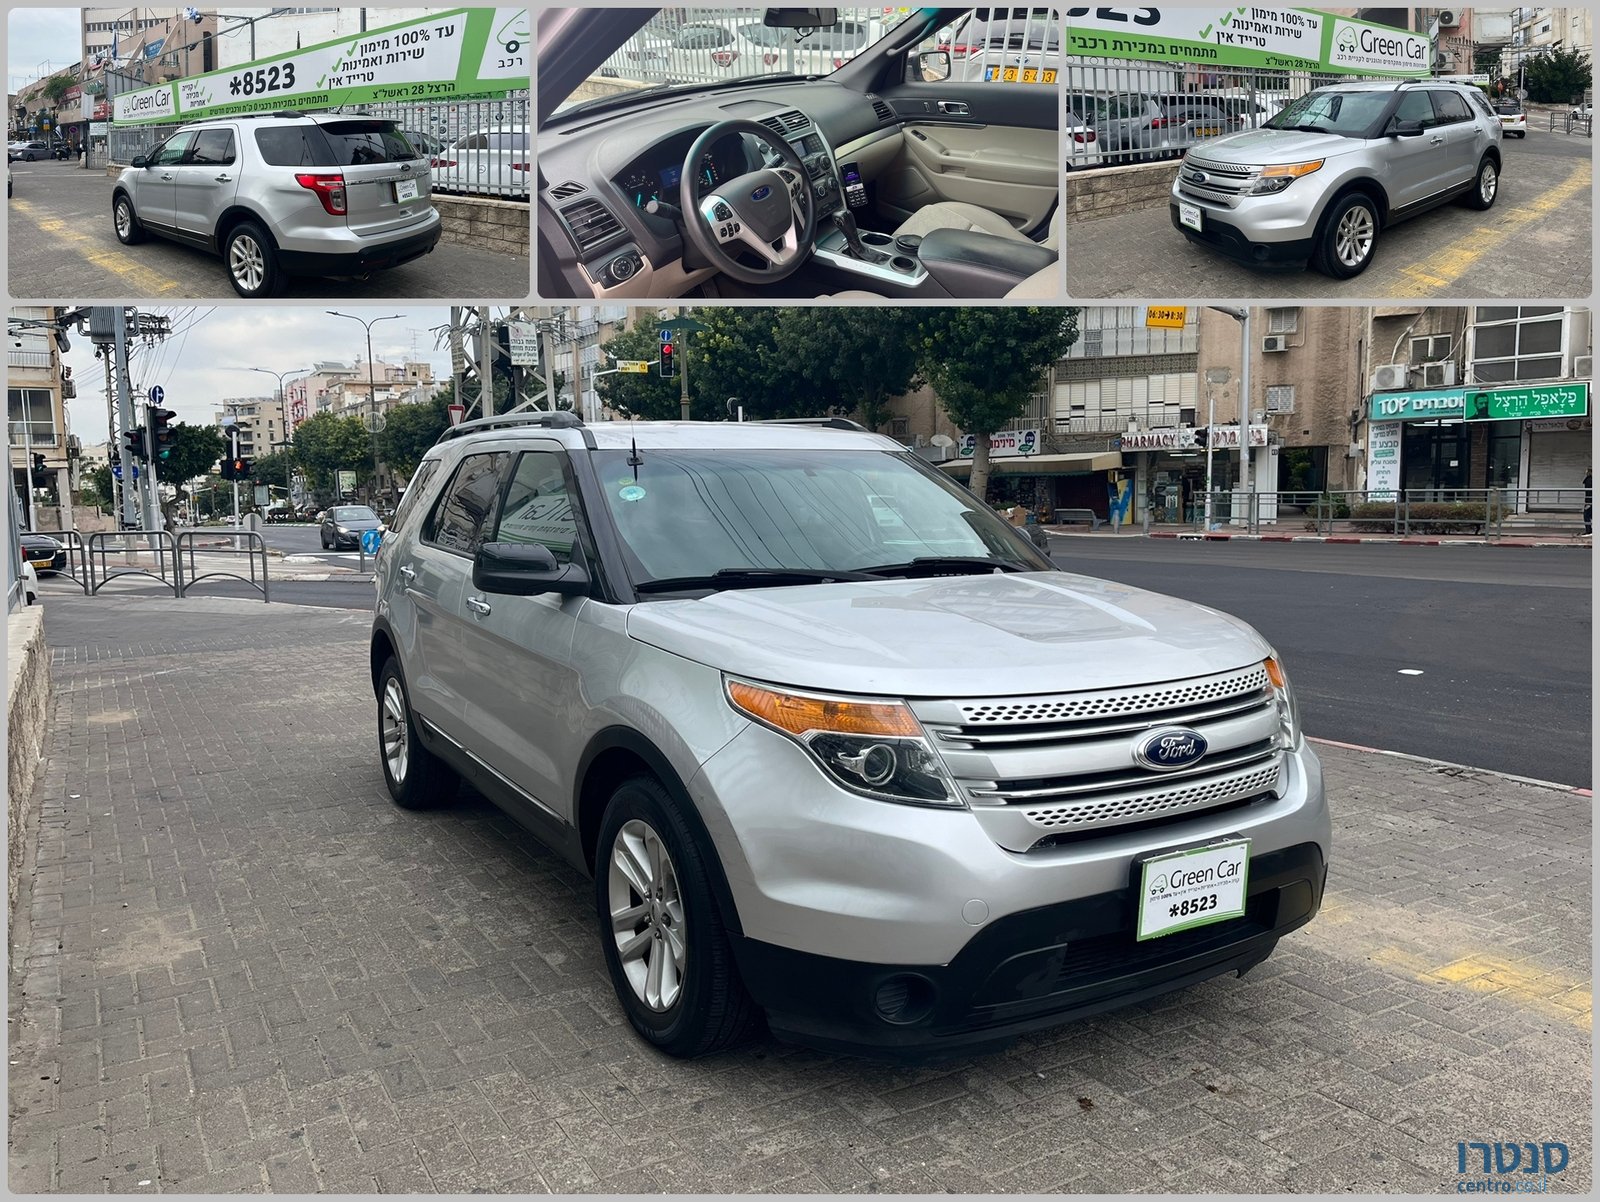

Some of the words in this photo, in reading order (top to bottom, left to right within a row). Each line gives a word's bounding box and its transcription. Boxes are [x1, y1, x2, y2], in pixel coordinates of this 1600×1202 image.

[1252, 8, 1278, 22] מימון
[1280, 12, 1305, 27] 100%
[1232, 18, 1273, 35] ואמינות
[1306, 18, 1318, 29] עד
[394, 30, 430, 48] 100%
[435, 25, 455, 39] עד
[1216, 31, 1234, 45] אין
[1275, 25, 1302, 39] שירות
[1070, 36, 1108, 50] רכבי
[1112, 40, 1166, 55] במכירת
[1237, 34, 1266, 47] טרייד
[1360, 29, 1403, 57] Green
[1406, 37, 1426, 60] Car
[360, 39, 390, 57] מימון
[1170, 44, 1218, 59] מתמחים
[386, 47, 425, 65] שירות
[498, 57, 523, 69] רכב
[341, 55, 383, 72] ואמינות
[1304, 60, 1320, 69] הרצל
[328, 76, 343, 90] אין
[346, 72, 375, 84] טרייד
[411, 85, 425, 96] 28
[427, 82, 456, 93] הרצל
[131, 93, 154, 112] Green
[155, 89, 171, 107] Car
[297, 94, 329, 105] מתמחים
[1378, 396, 1411, 415] TOP
[1121, 434, 1176, 448] PHARMACY
[1158, 735, 1196, 761] Ford
[1170, 866, 1214, 890] Green
[1217, 859, 1242, 881] Car
